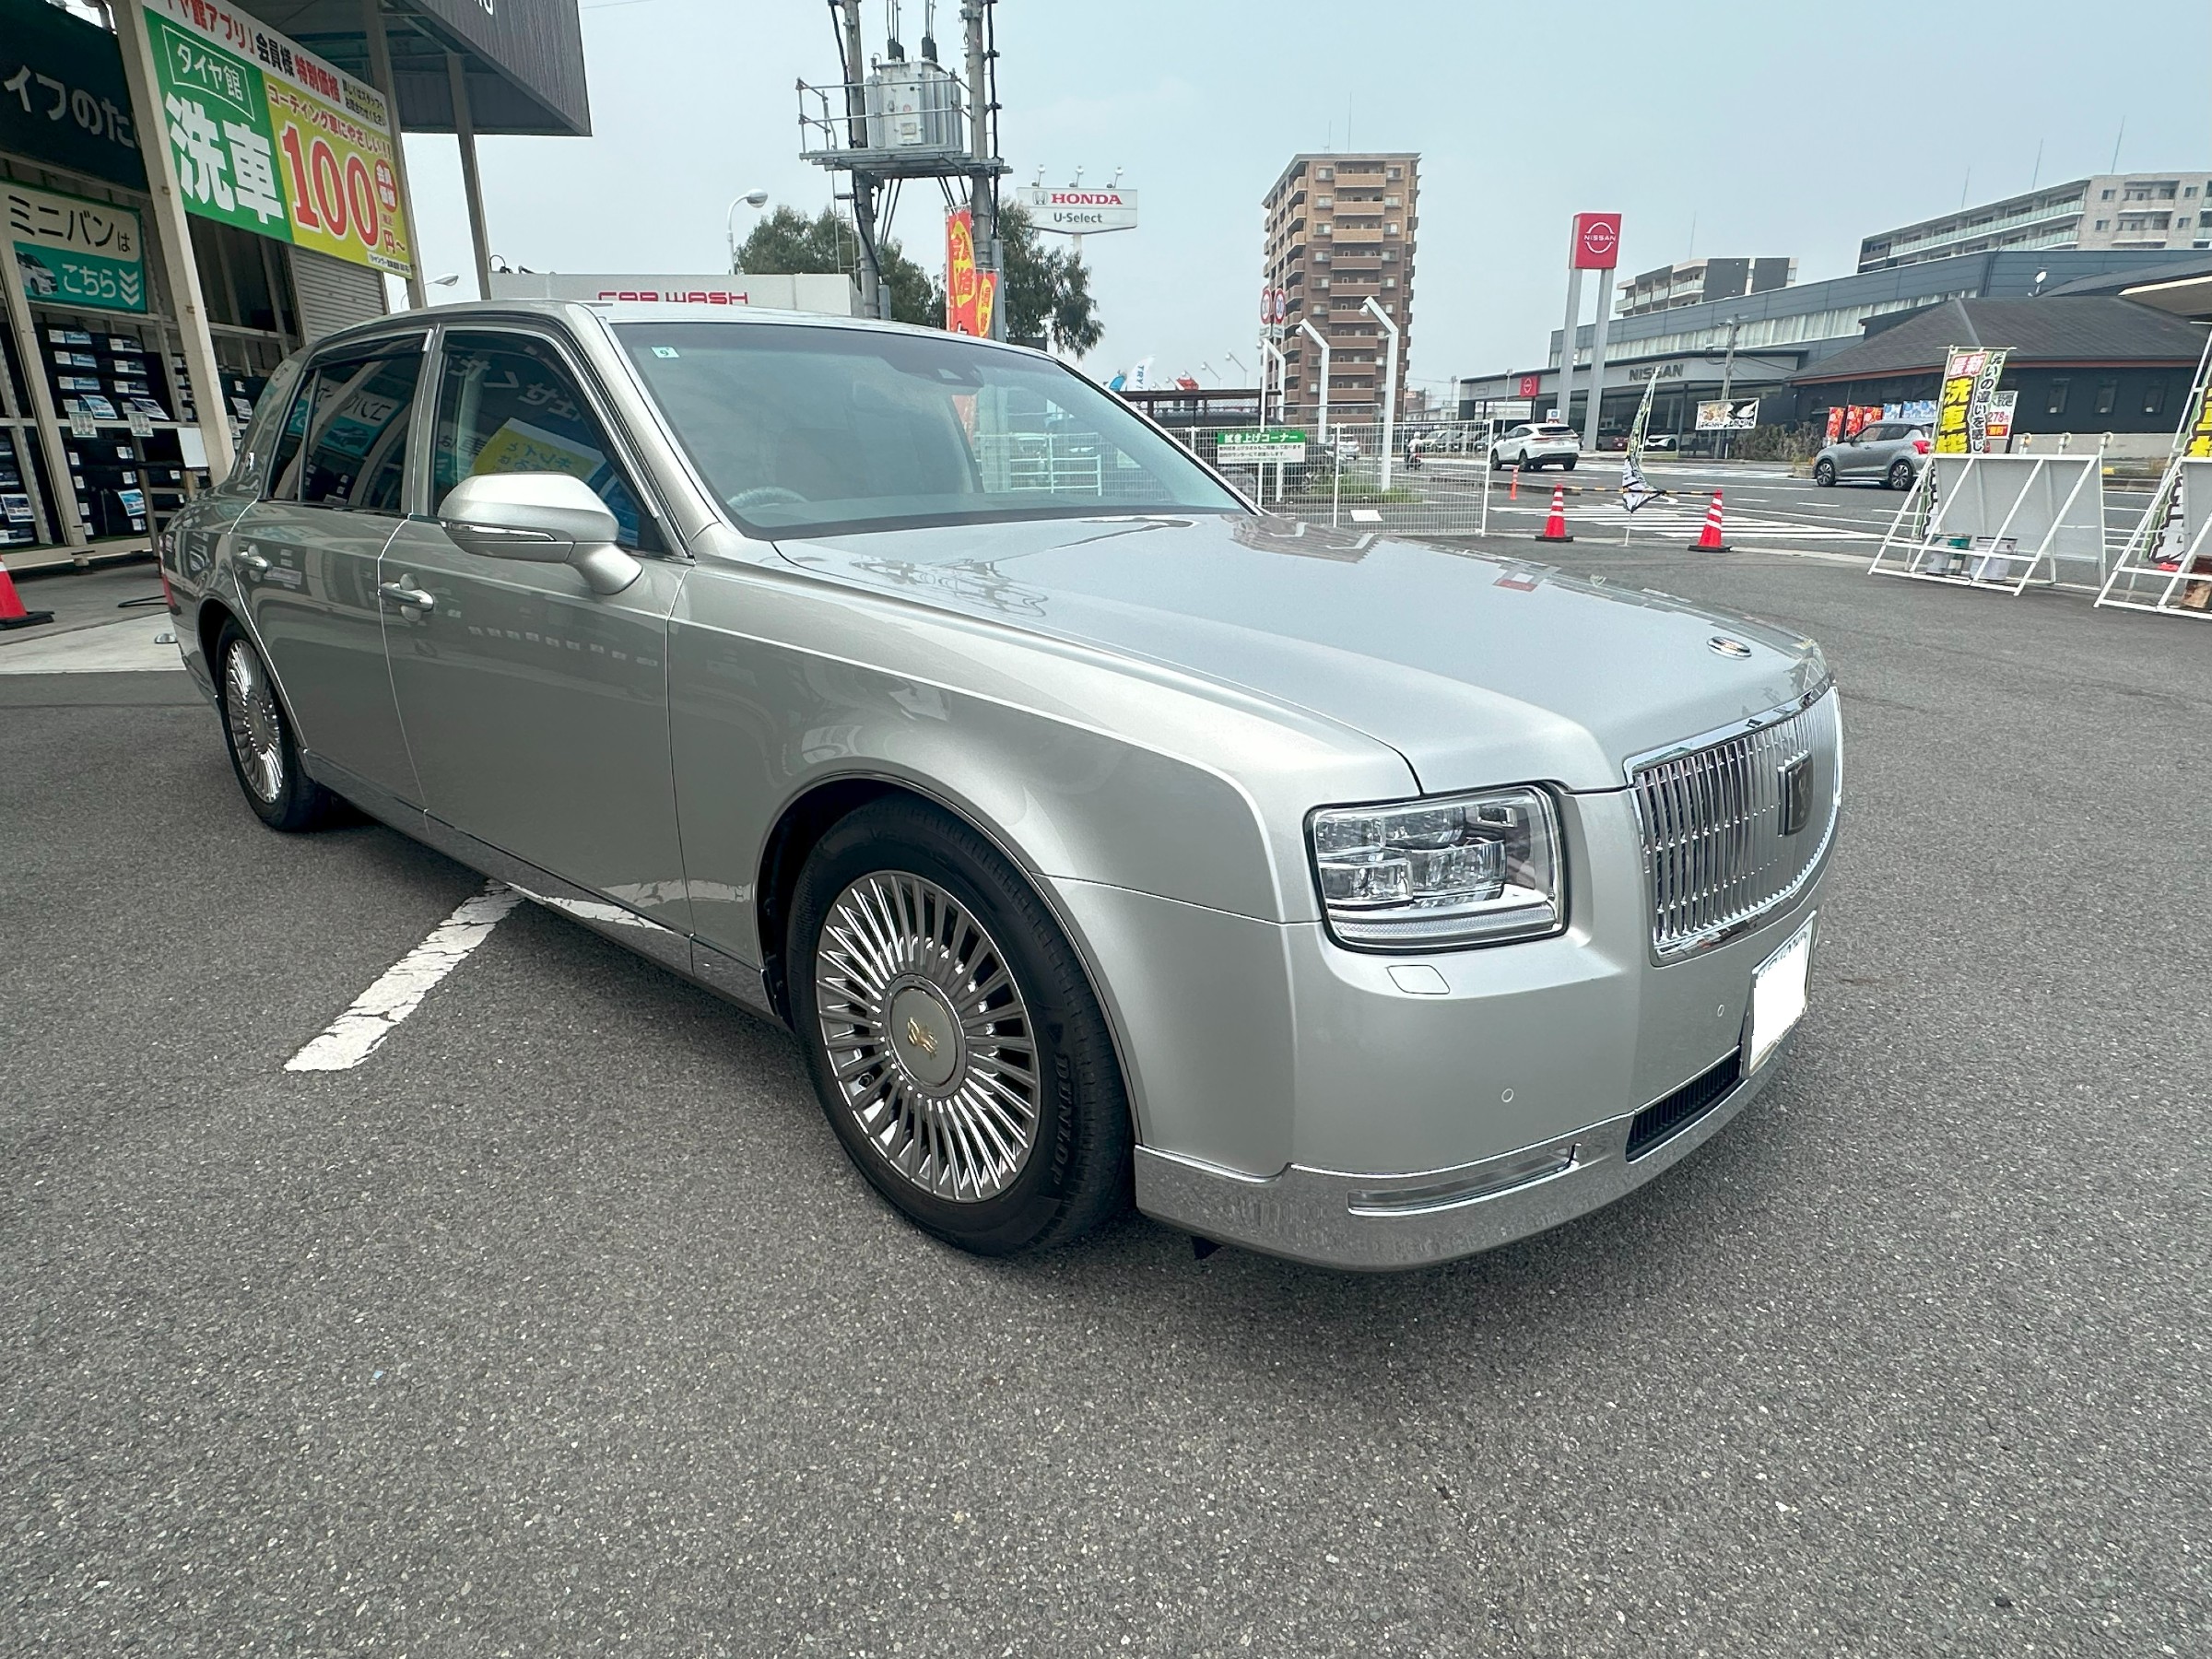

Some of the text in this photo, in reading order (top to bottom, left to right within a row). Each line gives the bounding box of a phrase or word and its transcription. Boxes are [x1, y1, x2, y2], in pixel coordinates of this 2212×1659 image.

[177, 43, 243, 101] タイヤ館
[4, 65, 140, 148] イフのた
[165, 92, 284, 225] 洗車
[282, 124, 379, 247] 100
[1051, 193, 1123, 205] HONDA
[1053, 212, 1103, 223] U-Select
[62, 263, 117, 299] こちら
[665, 291, 749, 305] WASH
